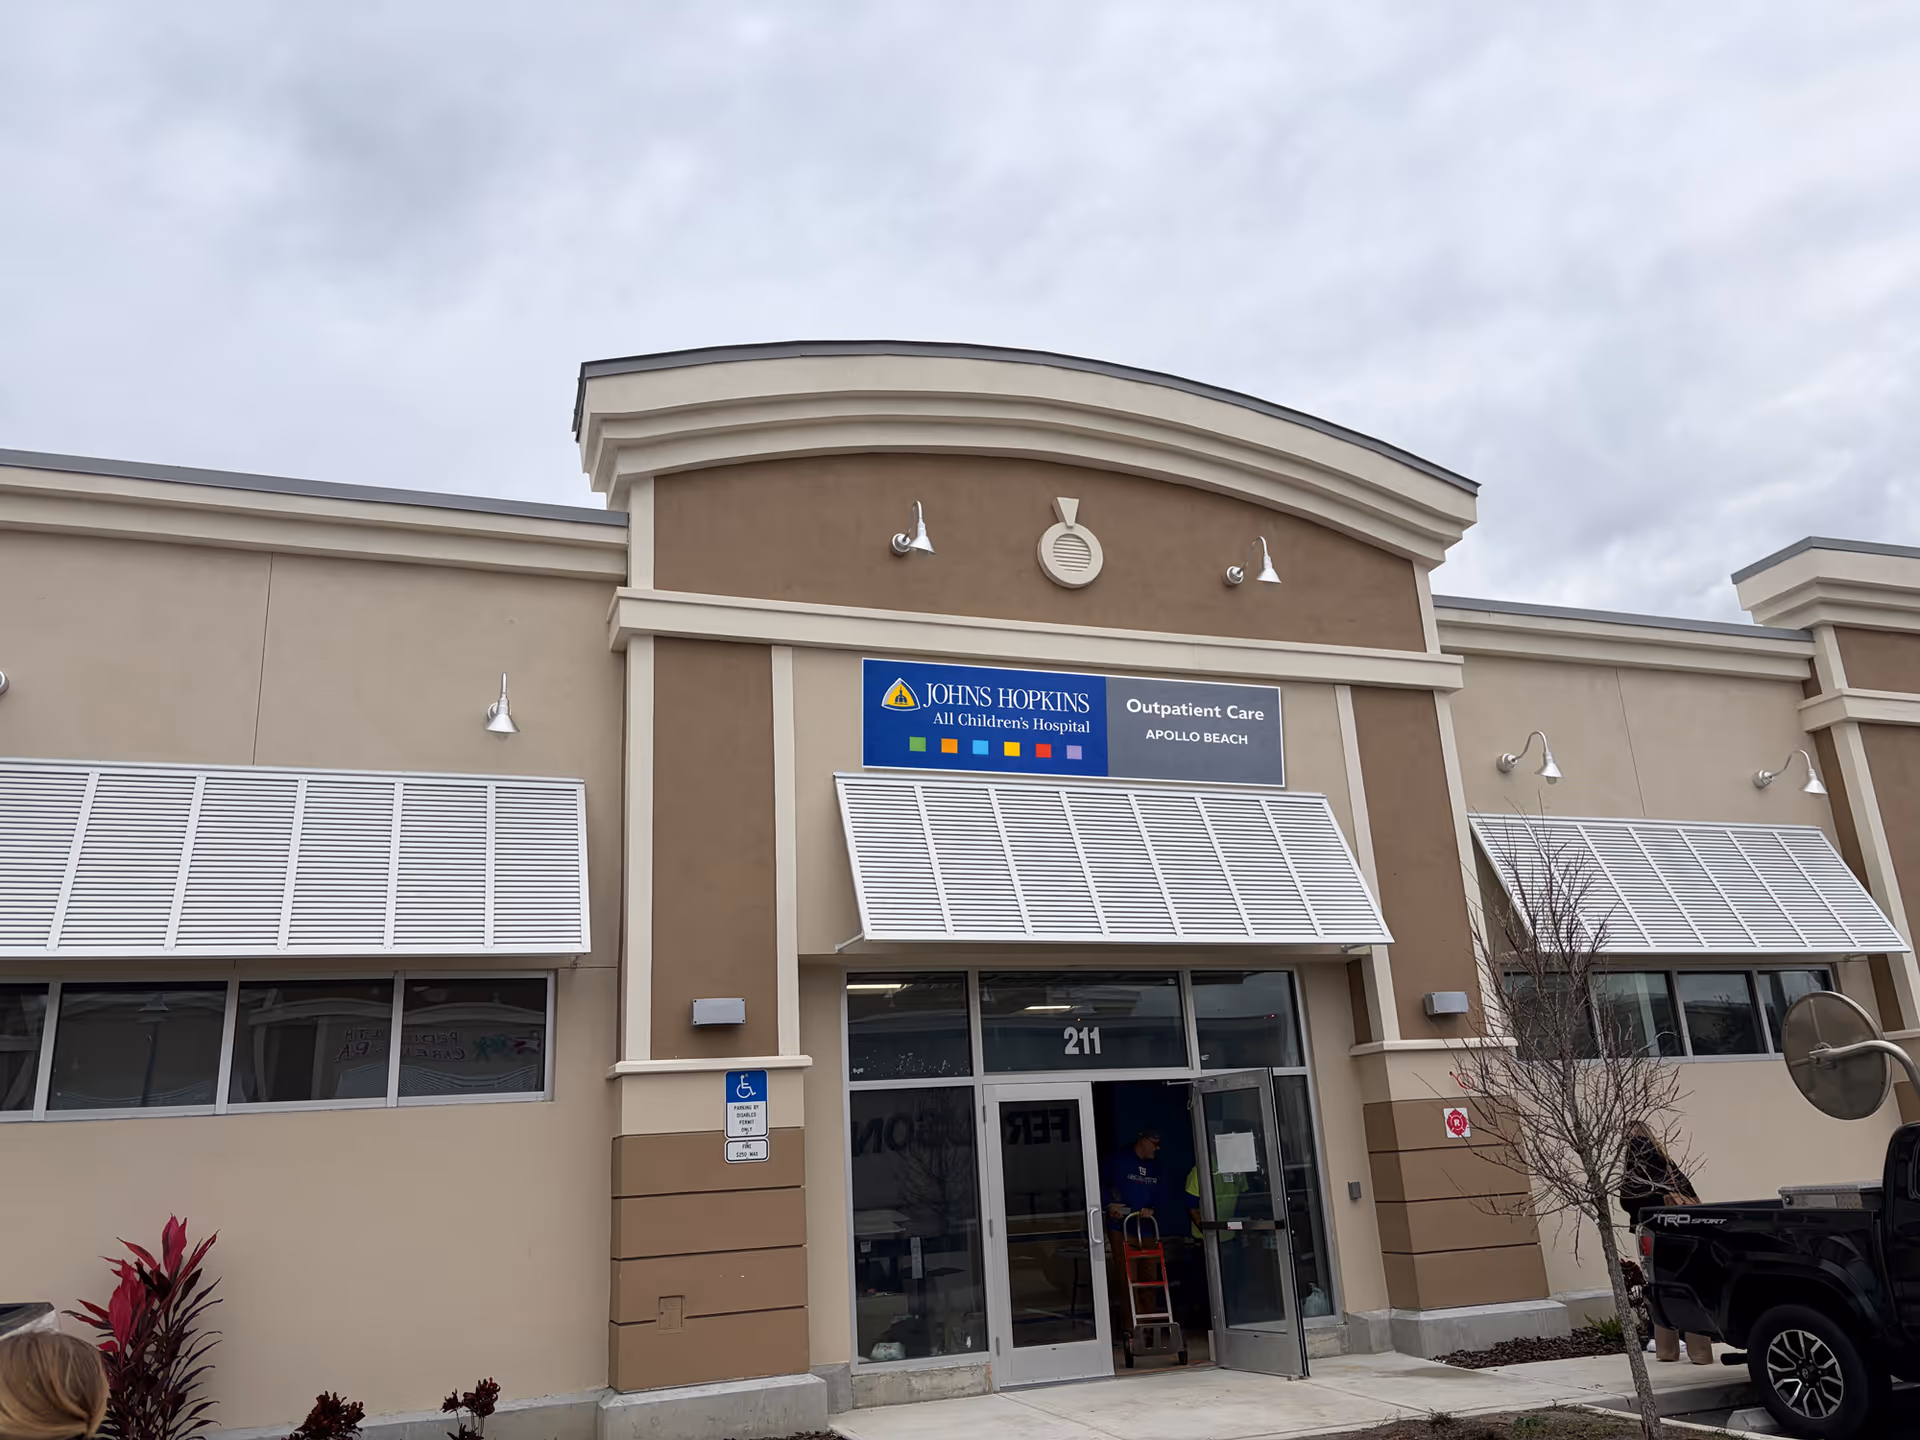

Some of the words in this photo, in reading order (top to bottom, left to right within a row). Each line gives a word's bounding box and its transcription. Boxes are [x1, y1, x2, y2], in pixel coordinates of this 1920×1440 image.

[923, 682, 992, 708] JOHNS
[998, 687, 1090, 713] HOPKINS
[1126, 698, 1222, 719] Outpatient
[1226, 705, 1265, 721] Care
[933, 712, 954, 725] All
[958, 712, 1029, 730] Children's
[1033, 718, 1091, 735] Hospital
[1145, 729, 1201, 742] APOLLO
[1203, 732, 1249, 745] BEACH
[1063, 1026, 1102, 1055] 211
[1453, 1119, 1461, 1127] R
[1653, 1213, 1691, 1227] TRD
